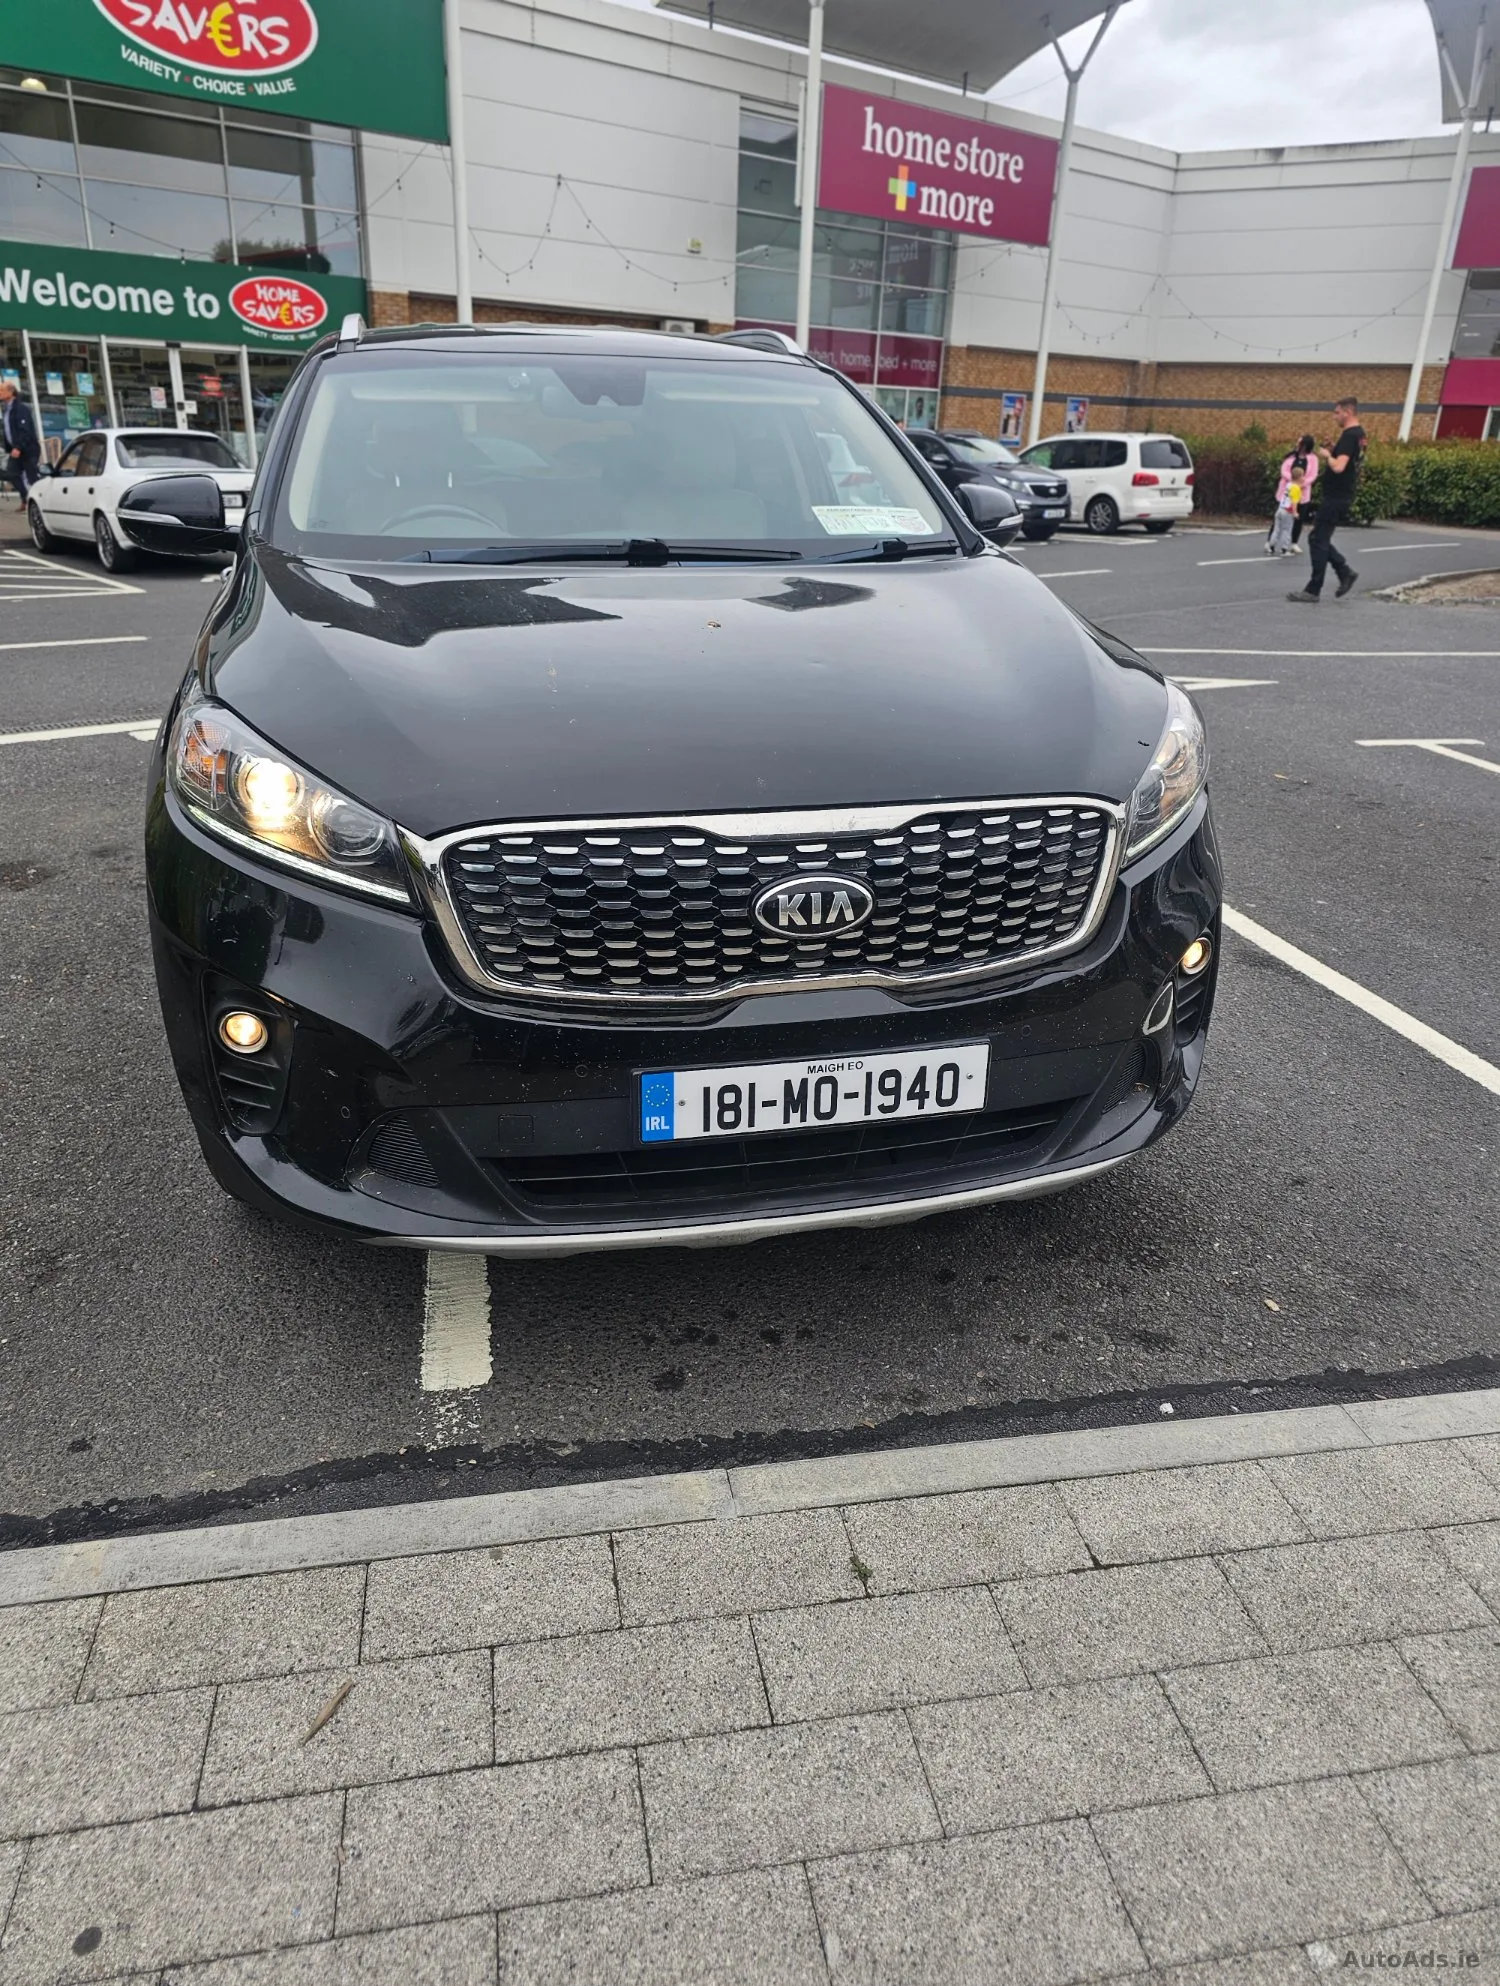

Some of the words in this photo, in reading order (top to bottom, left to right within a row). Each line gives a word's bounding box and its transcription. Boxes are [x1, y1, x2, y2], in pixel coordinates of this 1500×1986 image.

[121, 44, 181, 83] VARIETY
[193, 76, 246, 96] CHOICE
[254, 78, 296, 96] VALUE
[862, 106, 949, 168] home
[954, 137, 1024, 183] store
[918, 185, 994, 226] more
[0, 267, 174, 316] Welcome
[183, 286, 220, 320] to
[254, 283, 301, 303] HOME
[910, 358, 938, 372] more
[777, 891, 854, 926] KIA
[806, 1062, 844, 1075] MAIGH
[848, 1060, 864, 1071] EO
[703, 1062, 960, 1133] 181-MO-1940
[645, 1116, 670, 1131] IRL
